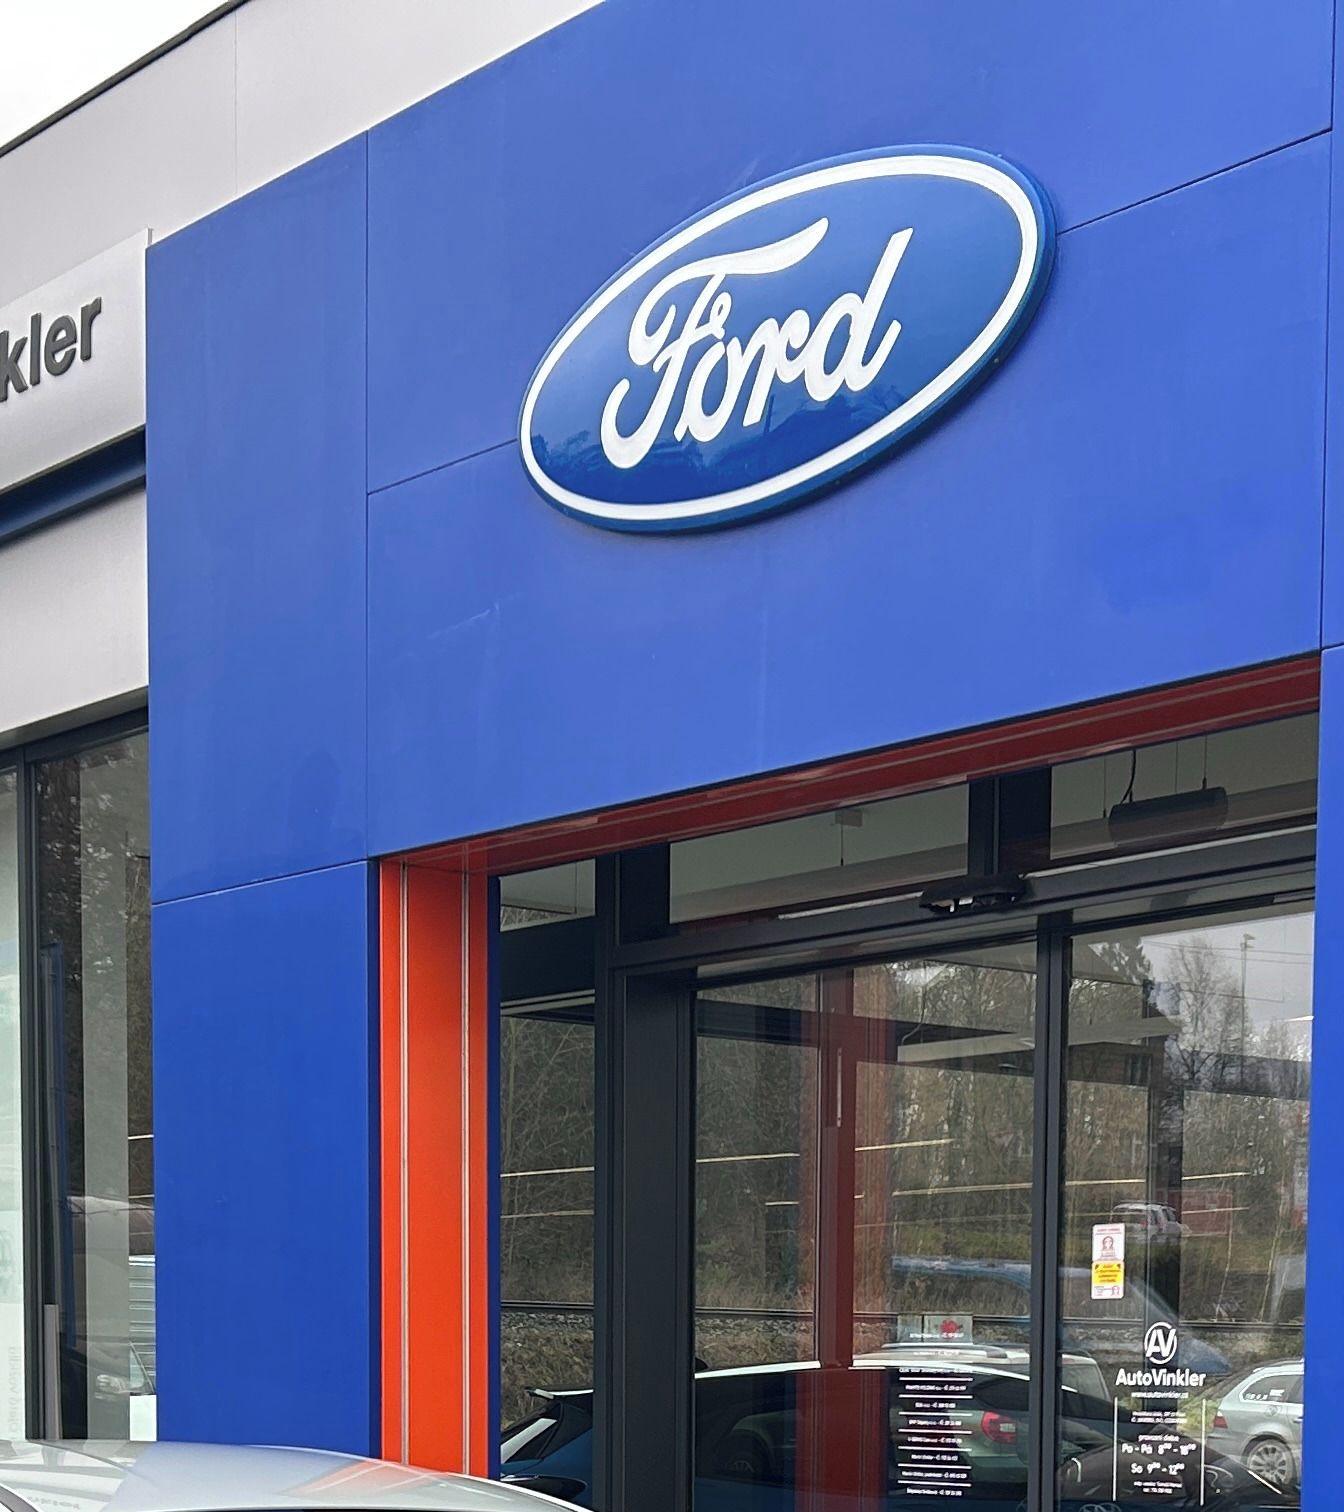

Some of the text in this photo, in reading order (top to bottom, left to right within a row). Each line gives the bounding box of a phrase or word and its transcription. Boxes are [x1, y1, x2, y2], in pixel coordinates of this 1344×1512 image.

[600, 217, 914, 470] Ford
[1115, 1367, 1207, 1388] AutoVinkler
[1121, 1443, 1134, 1454] Po
